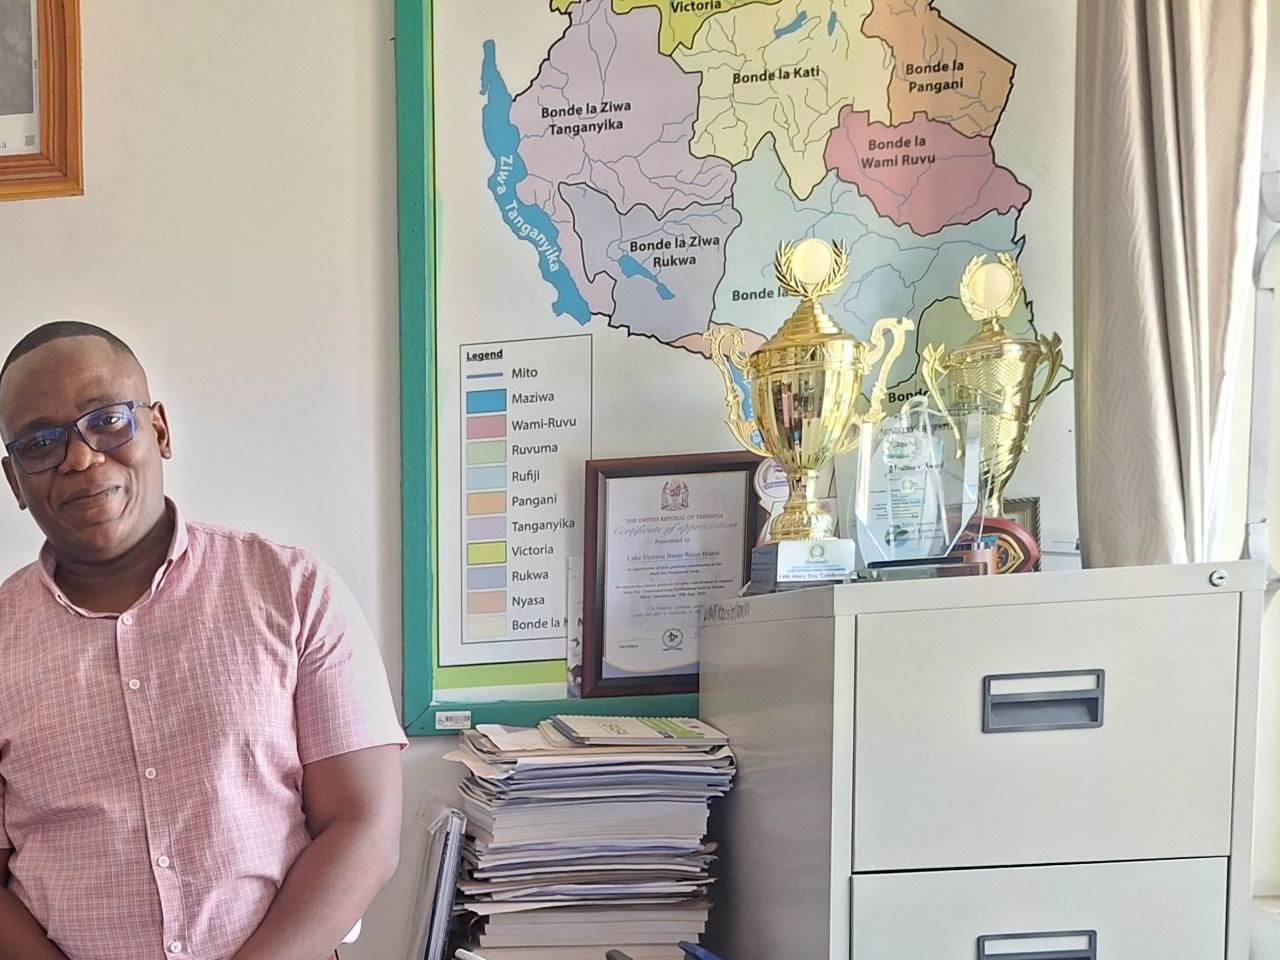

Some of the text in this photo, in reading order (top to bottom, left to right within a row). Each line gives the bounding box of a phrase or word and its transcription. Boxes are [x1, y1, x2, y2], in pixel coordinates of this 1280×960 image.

[671, 0, 721, 13] Victoria
[906, 60, 964, 75] Bonde la
[733, 65, 820, 84] Bonde la Kati
[909, 78, 963, 94] Pangani
[541, 101, 631, 118] Bonde la Ziwa
[549, 119, 623, 136] Tanganyika
[868, 136, 926, 150] Bonde la
[861, 154, 935, 169] Wami Ruvu
[497, 155, 559, 272] Ziwa Tanganyika
[630, 235, 720, 252] Bonde la Ziwa
[653, 255, 696, 268] Rukwa
[733, 288, 774, 301] Bonde
[466, 349, 503, 361] Legend
[512, 368, 538, 378] Mito
[512, 392, 554, 404] Maziwa
[512, 418, 576, 430] Wami-Ruvu
[512, 444, 558, 455] Ruvuma
[512, 470, 540, 483] Rufiji
[512, 494, 557, 508] Pangani
[512, 518, 575, 533] Tanganyika
[512, 545, 554, 556] Victoria
[512, 570, 548, 581] Rukwa
[512, 596, 545, 608] Nyasa
[512, 618, 560, 630] Bonde la
